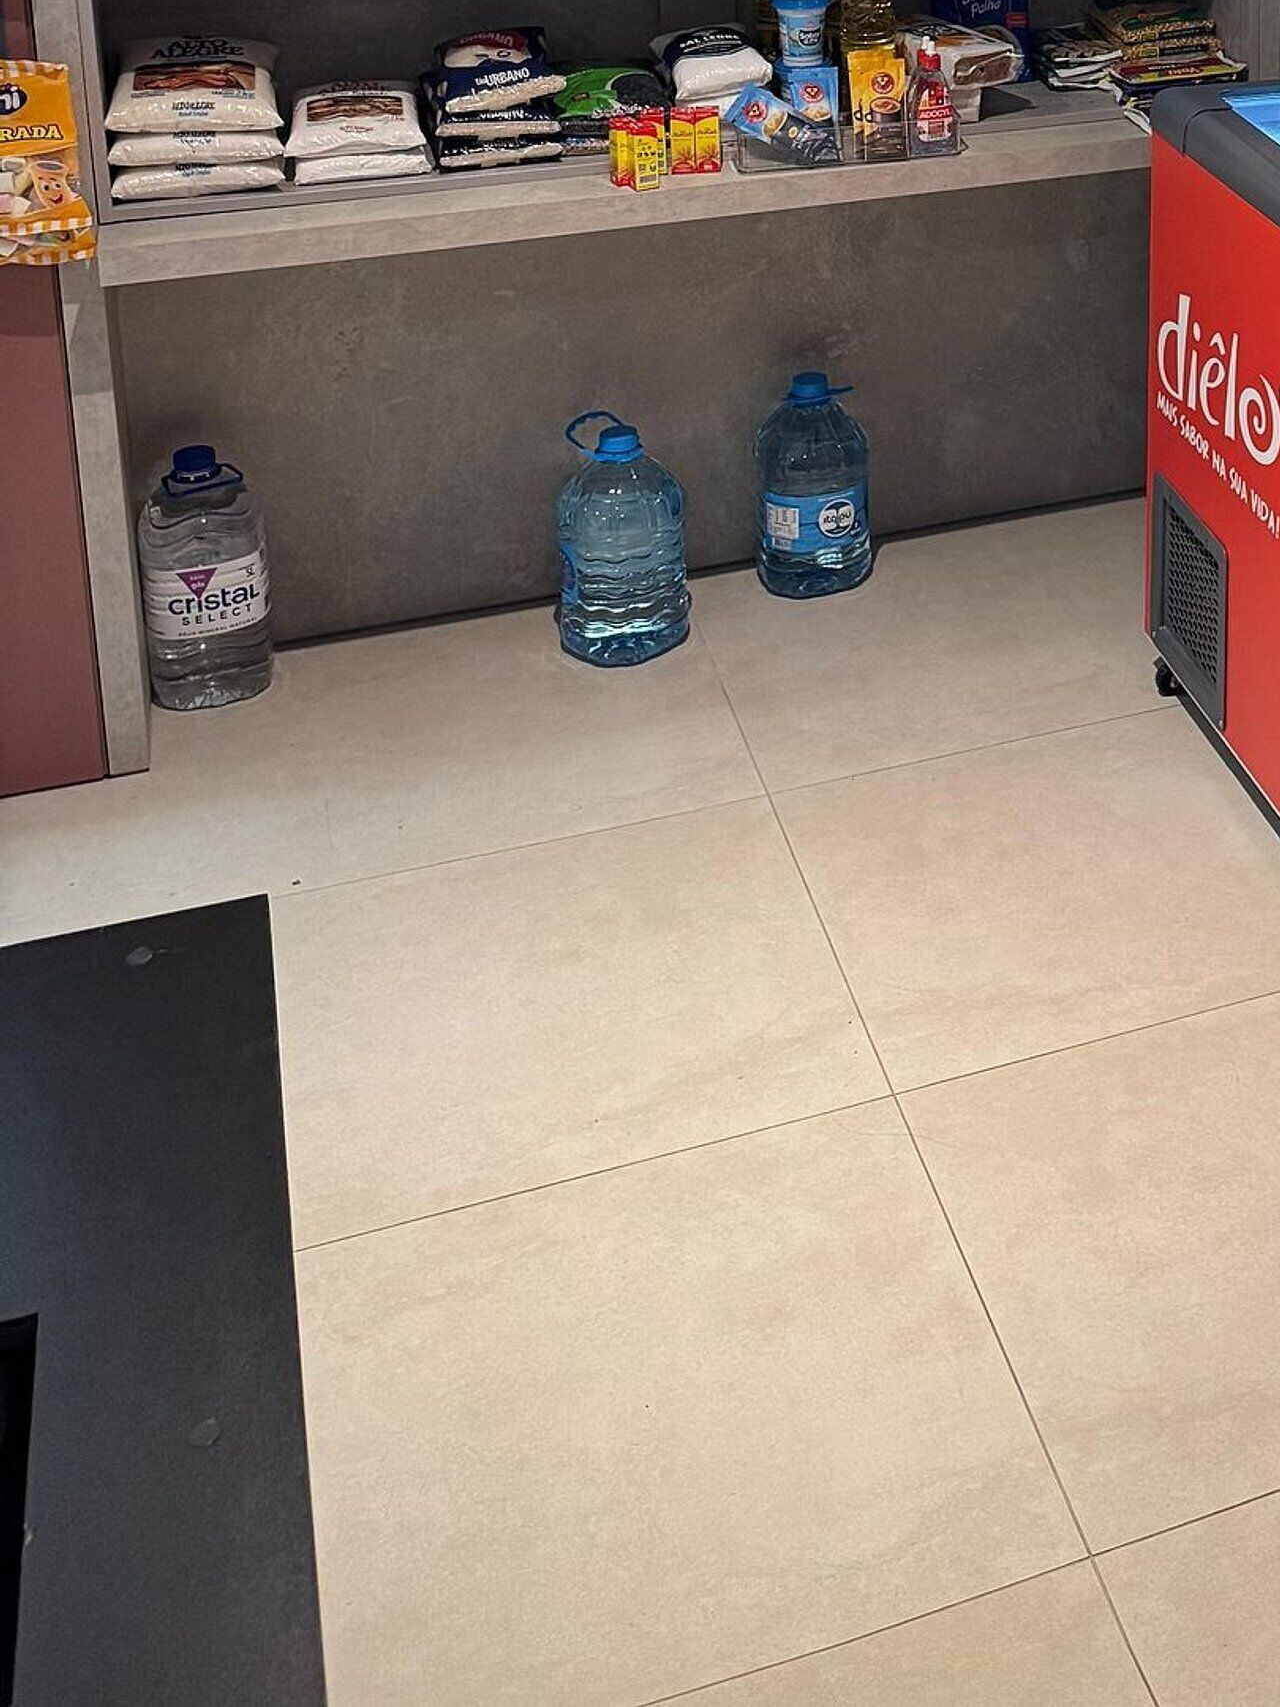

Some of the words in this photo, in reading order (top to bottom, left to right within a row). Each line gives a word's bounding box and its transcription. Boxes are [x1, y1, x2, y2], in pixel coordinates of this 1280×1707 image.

[484, 67, 531, 87] URBANO
[1156, 390, 1179, 428] MAIS
[1179, 414, 1210, 461] SABOR
[1211, 449, 1228, 482] NA
[1229, 467, 1249, 504] SUA
[1250, 487, 1280, 540] VIDA!
[168, 583, 261, 615] cristal
[181, 602, 252, 626] SELECT
